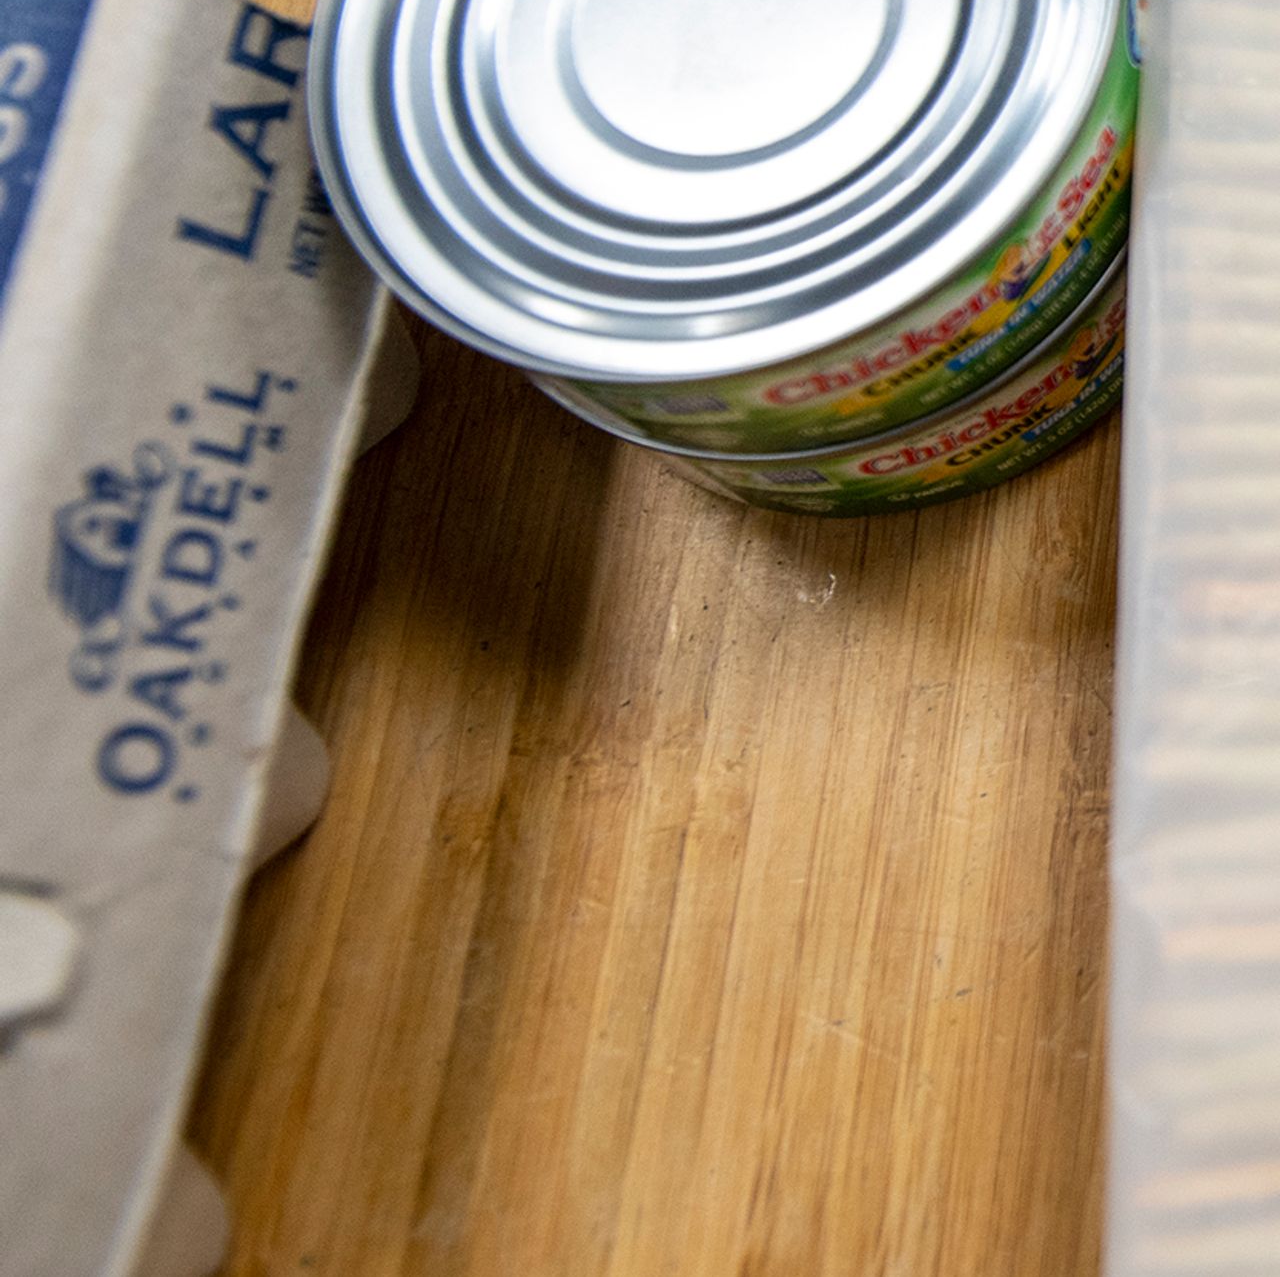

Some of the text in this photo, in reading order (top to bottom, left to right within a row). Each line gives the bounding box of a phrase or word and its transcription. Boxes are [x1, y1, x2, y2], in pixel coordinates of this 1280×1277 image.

[857, 363, 1071, 477] Chicken
[945, 403, 1054, 468] CHUNK
[95, 368, 275, 795] OAKDELL
